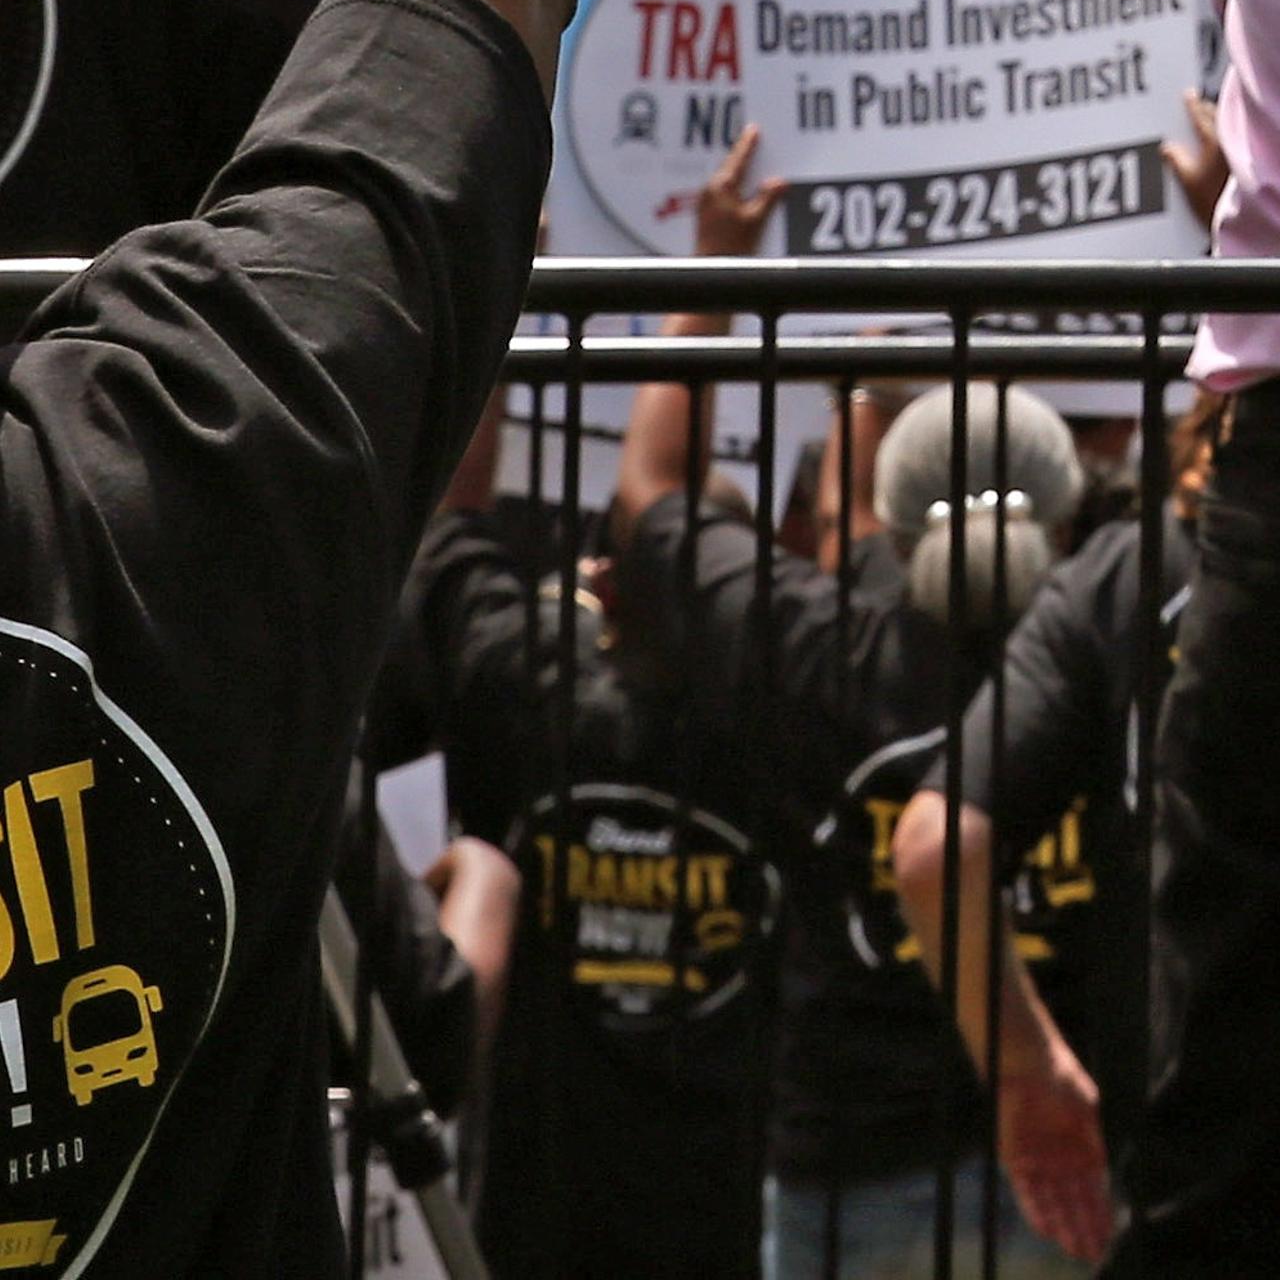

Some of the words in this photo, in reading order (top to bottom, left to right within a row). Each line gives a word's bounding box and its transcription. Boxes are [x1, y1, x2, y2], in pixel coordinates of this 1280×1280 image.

[797, 74, 838, 132] in
[852, 60, 985, 132] Public
[999, 44, 1148, 118] Transit
[811, 152, 1143, 253] 202-224-3121
[9, 1137, 85, 1185] HEARD
